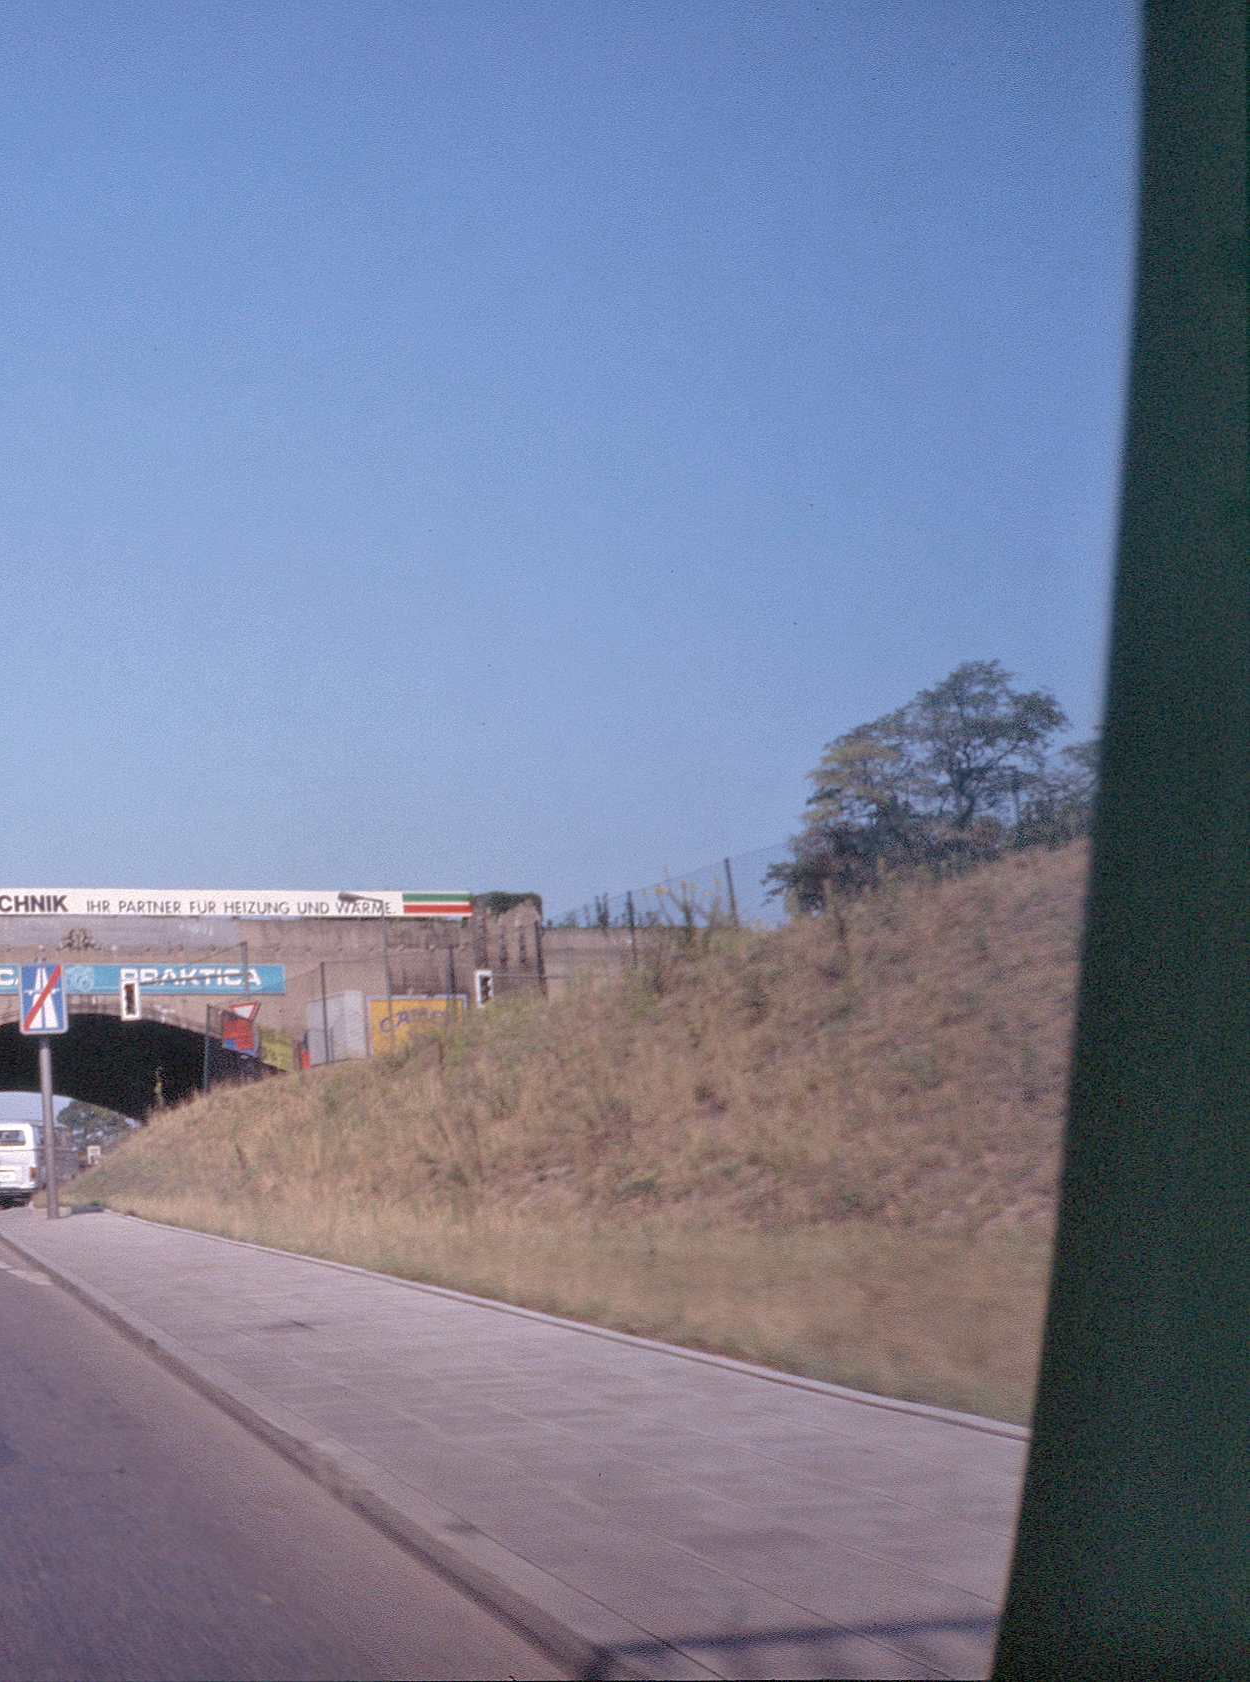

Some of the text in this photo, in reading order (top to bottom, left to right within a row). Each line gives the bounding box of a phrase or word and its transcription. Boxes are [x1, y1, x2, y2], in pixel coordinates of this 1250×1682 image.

[86, 900, 110, 913] IHR
[118, 900, 181, 914] PARTNER
[224, 901, 290, 914] HEIZUNG
[297, 901, 330, 915] UND
[120, 968, 262, 986] PRAKTICA
